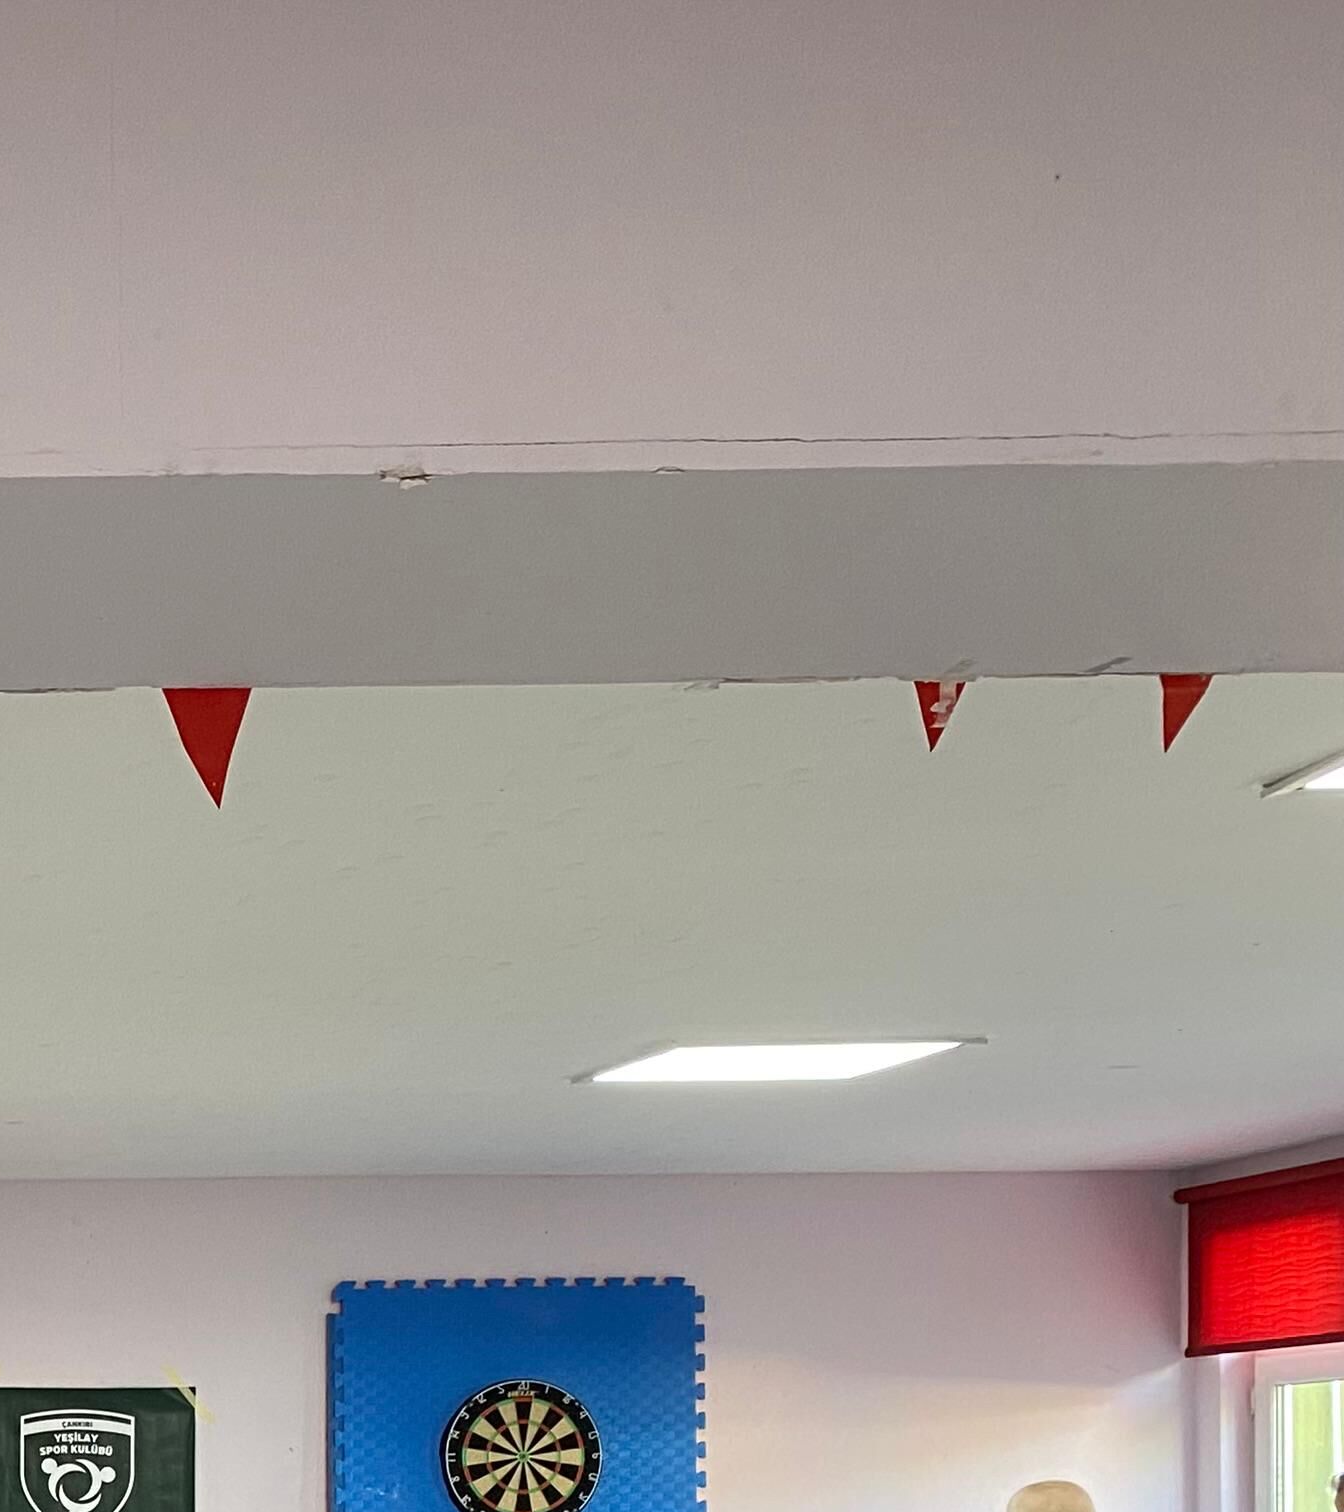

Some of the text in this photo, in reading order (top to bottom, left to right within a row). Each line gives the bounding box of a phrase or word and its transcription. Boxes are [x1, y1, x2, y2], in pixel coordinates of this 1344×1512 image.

[54, 1432, 99, 1444] YEŞİLAY
[39, 1444, 113, 1456] SPOR KULÜBÜ
